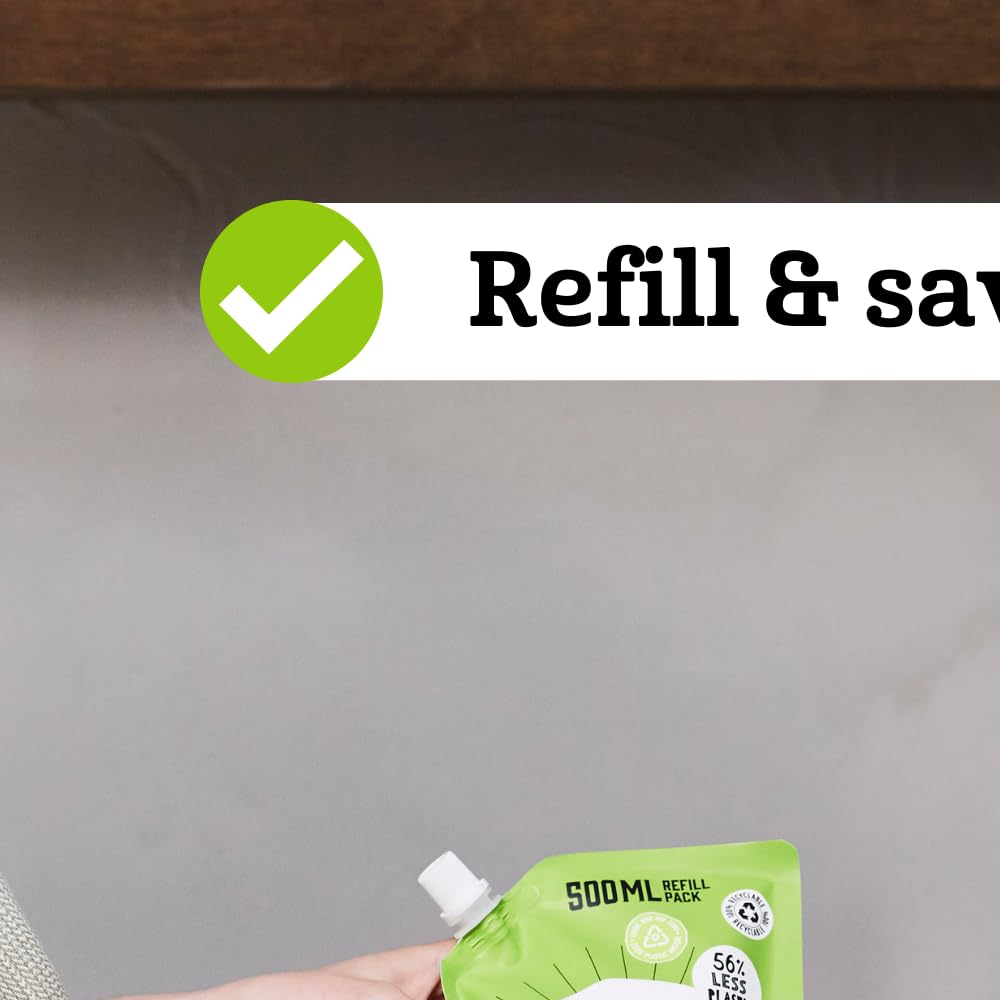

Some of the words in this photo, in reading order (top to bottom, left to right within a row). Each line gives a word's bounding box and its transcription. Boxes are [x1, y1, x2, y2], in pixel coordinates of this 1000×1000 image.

[662, 879, 710, 891] REFILL
[665, 891, 701, 903] PACK
[713, 952, 745, 976] 56%
[711, 972, 747, 994] LESS
